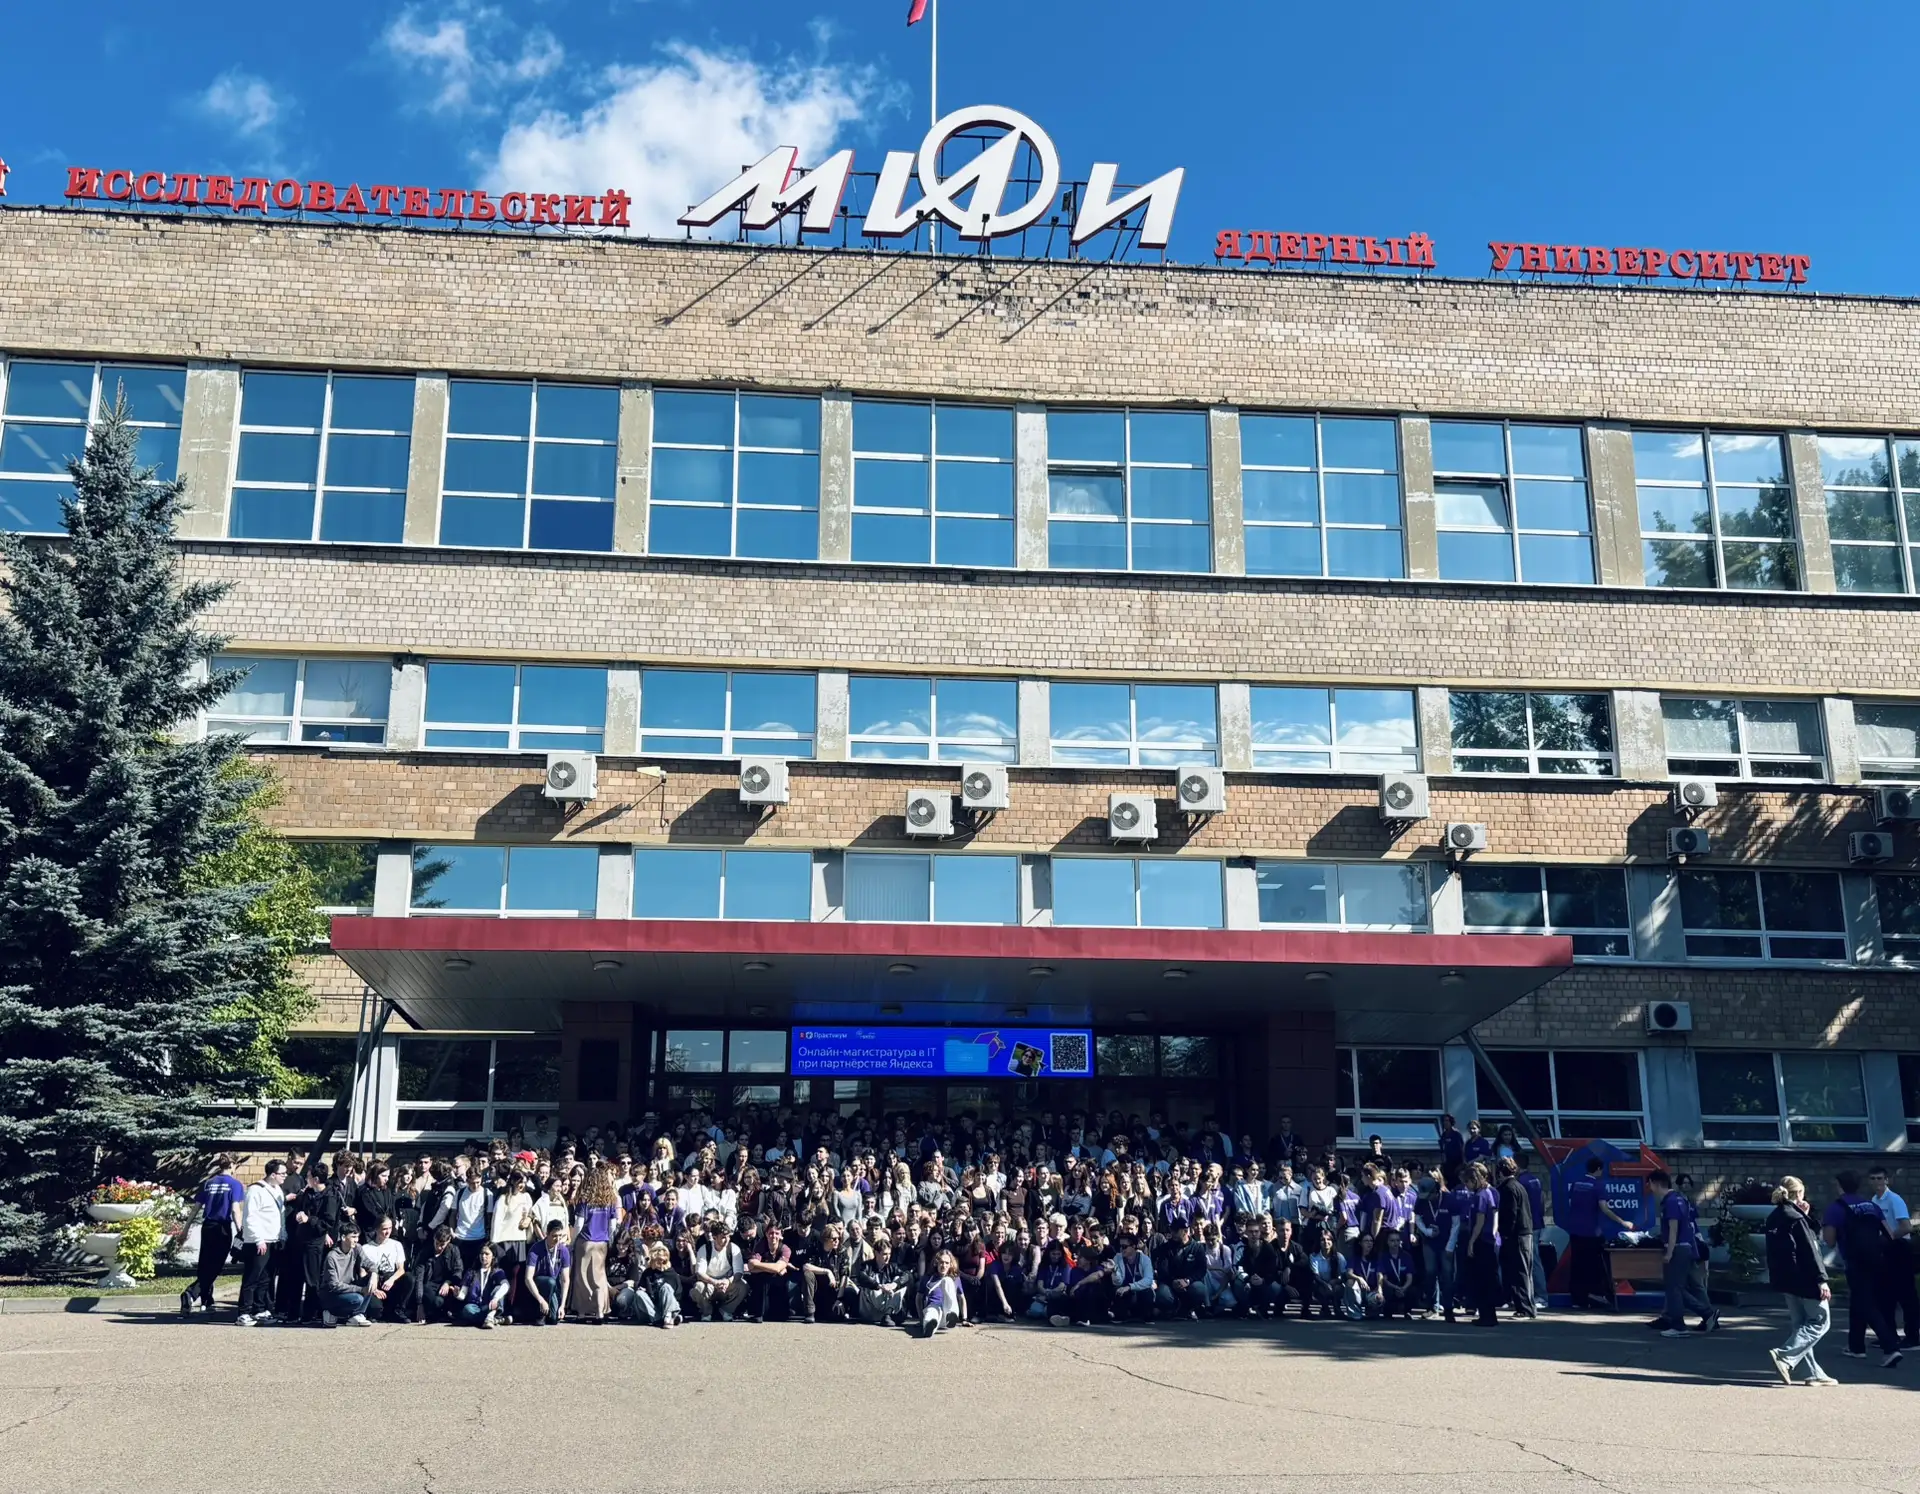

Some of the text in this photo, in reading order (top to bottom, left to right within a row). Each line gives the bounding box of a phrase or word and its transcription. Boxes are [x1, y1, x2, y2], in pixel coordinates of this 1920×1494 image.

[64, 165, 632, 228] ИССЛЕДОВАТЕЛЬСКИЙ
[1214, 229, 1811, 284] ЯДЕРНЫЙ УНИВЕРСИТЕТ
[813, 1031, 848, 1040] Практикум
[798, 1046, 917, 1059] Онлайн-магистратура
[927, 1047, 937, 1057] IT
[798, 1059, 933, 1070] при партнёрстве Яндекса
